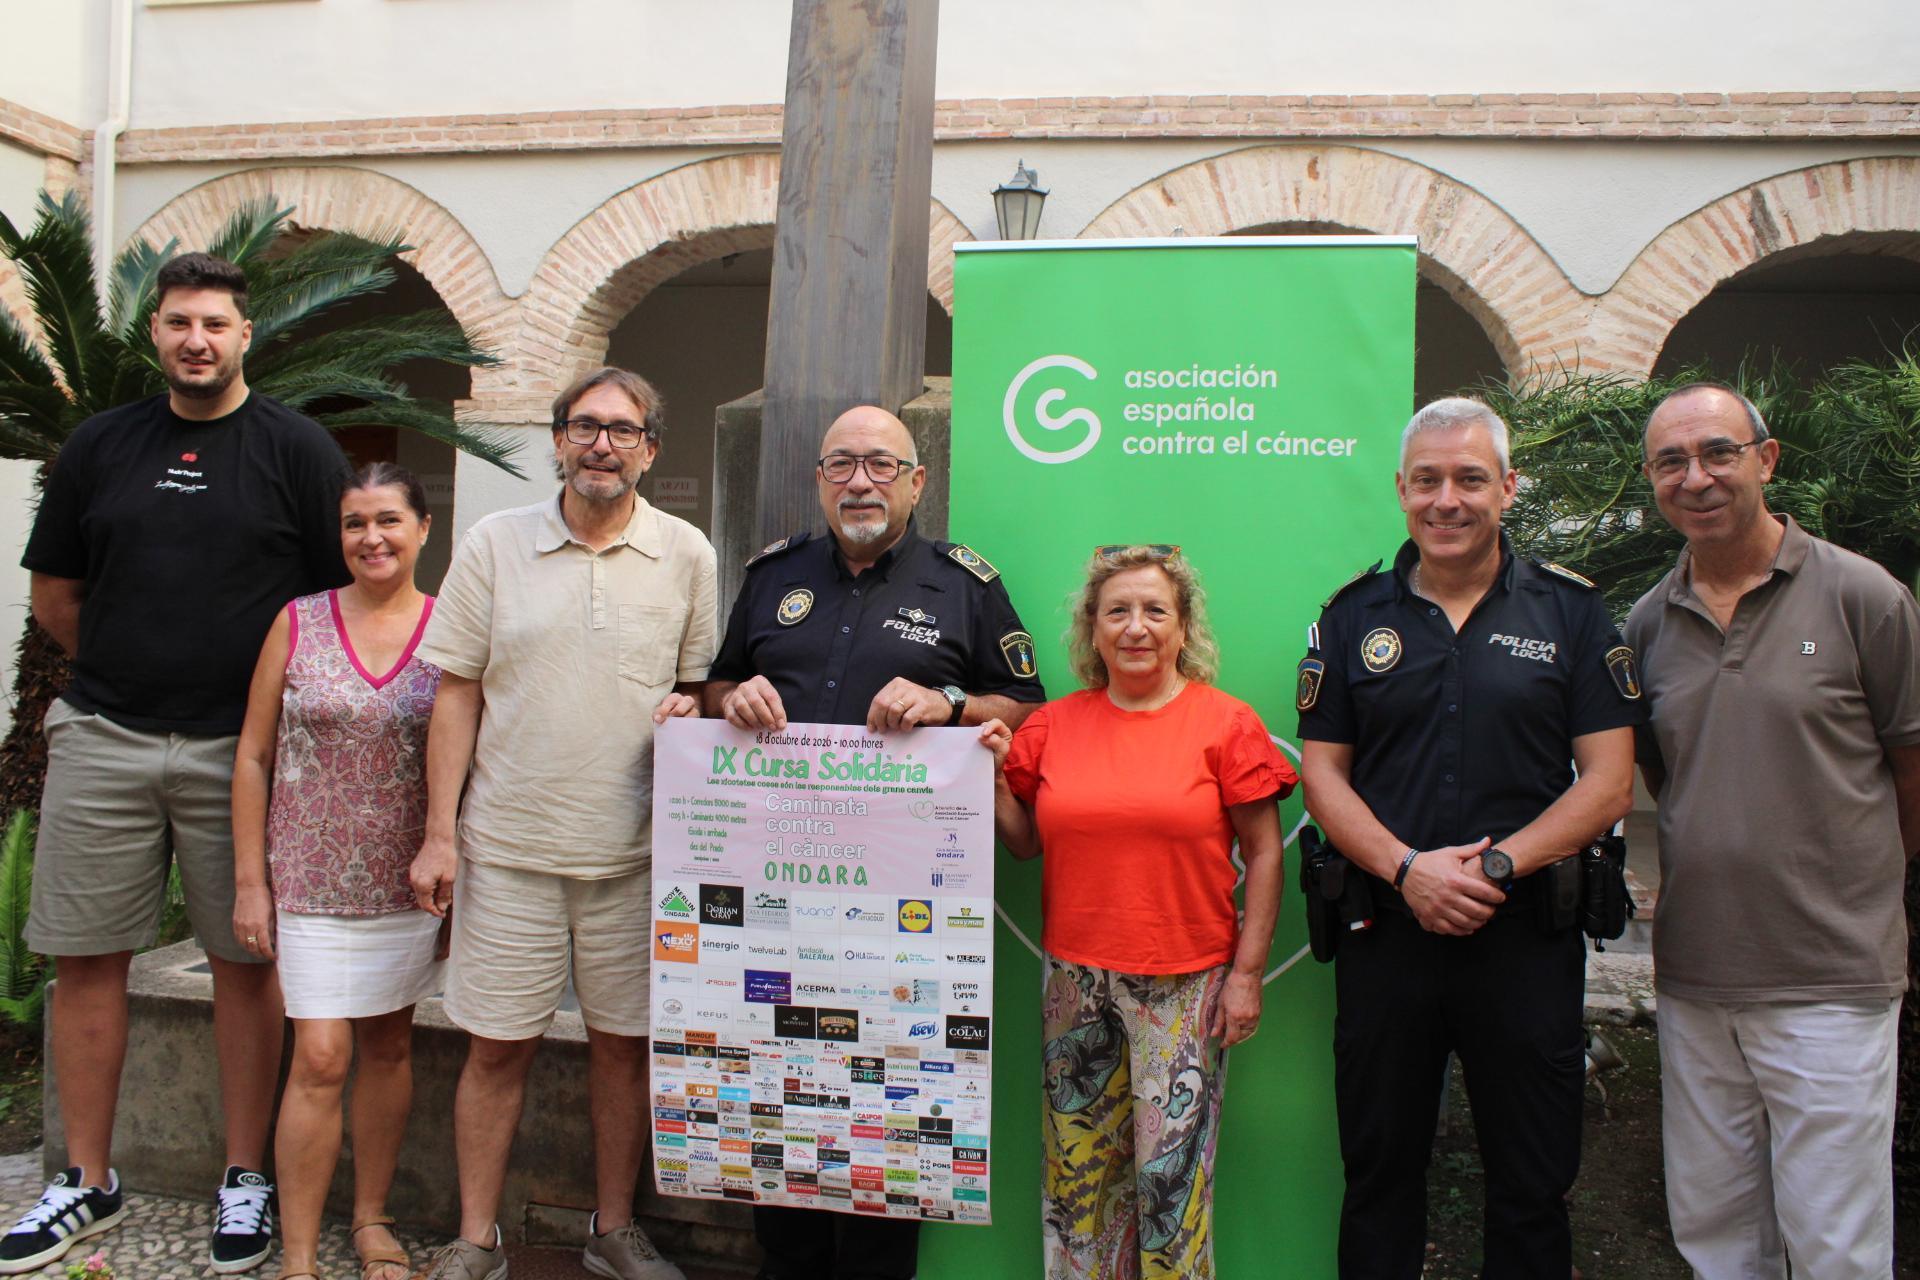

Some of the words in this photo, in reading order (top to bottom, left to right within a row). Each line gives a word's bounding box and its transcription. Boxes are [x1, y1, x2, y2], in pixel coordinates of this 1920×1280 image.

[1124, 363, 1277, 388] asociación
[1123, 396, 1255, 428] española
[1122, 432, 1215, 456] contra
[1222, 430, 1249, 455] el
[1255, 431, 1358, 457] cáncer
[882, 619, 941, 639] POLICIA
[900, 631, 939, 647] LOCAL
[1487, 633, 1557, 654] POLICIA
[1801, 641, 1816, 655] B
[1510, 647, 1555, 664] LOCAL
[756, 733, 763, 745] 18
[765, 732, 799, 747] d'octubre
[800, 734, 811, 747] de
[813, 735, 832, 748] 2026
[861, 736, 884, 750] hores
[712, 745, 738, 776] IX
[744, 747, 810, 779] Cursa
[817, 751, 928, 783] Solidària
[863, 784, 881, 793] dels
[765, 792, 868, 816] Caminata
[766, 816, 836, 835] contra
[765, 837, 784, 855] el
[790, 837, 867, 859] càncer
[764, 861, 868, 886] ONDARA
[659, 889, 676, 909] LEROY
[674, 886, 696, 912] MERLIN
[661, 934, 696, 946] NEXO
[796, 984, 836, 993] ACERMA
[949, 1027, 987, 1038] COLAU
[688, 1153, 718, 1162] ONDARA
